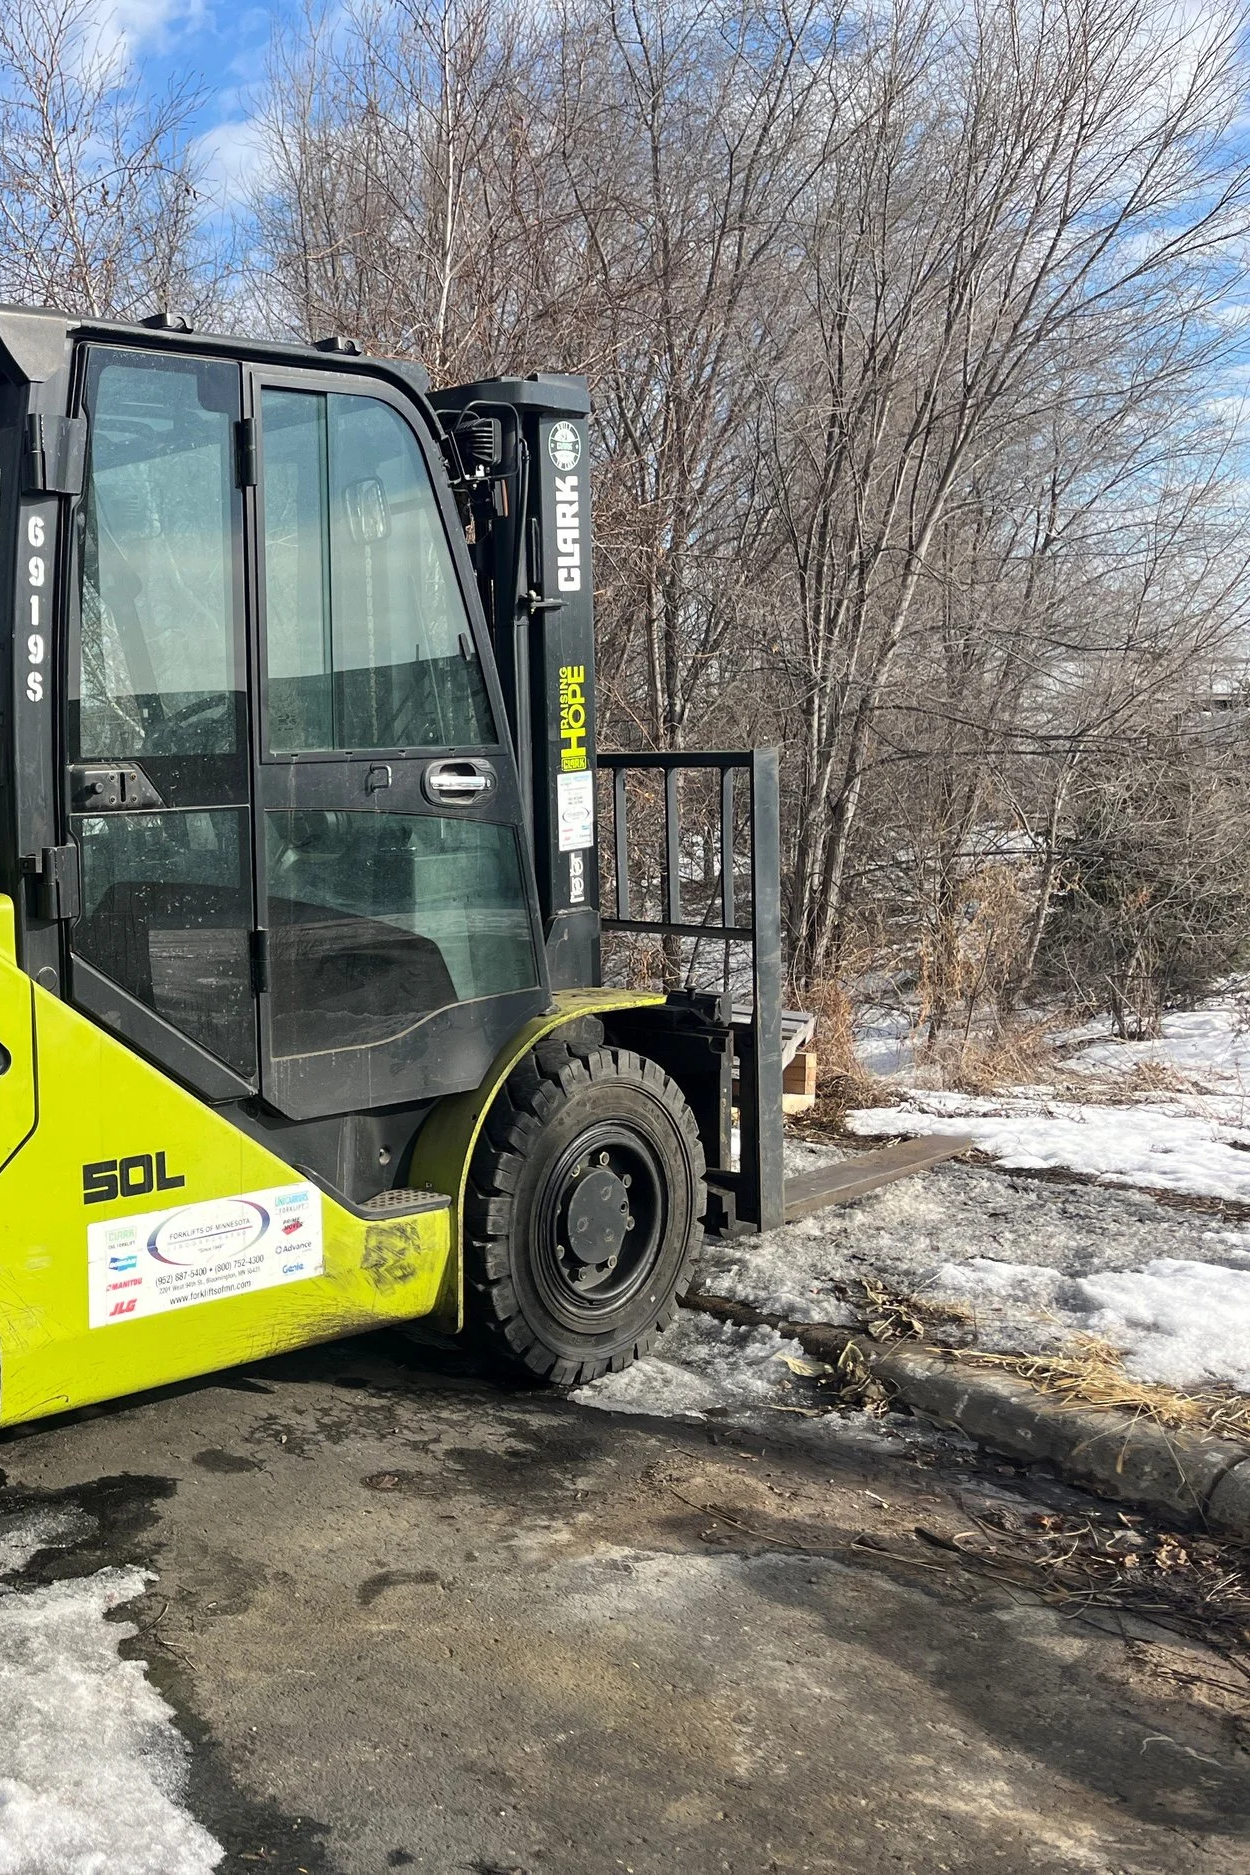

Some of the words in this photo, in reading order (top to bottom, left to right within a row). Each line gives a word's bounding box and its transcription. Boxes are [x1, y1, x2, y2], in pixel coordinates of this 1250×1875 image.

[555, 475, 581, 592] CLARK
[559, 666, 570, 729] RAISING
[560, 665, 587, 757] HOPE
[169, 1226, 204, 1240] FORKLIFTS
[205, 1223, 214, 1233] OF
[215, 1217, 250, 1231] MINNESOTA
[282, 1241, 312, 1253] Advance
[155, 1274, 174, 1287] (952)
[174, 1266, 207, 1282] 887-5400
[214, 1261, 232, 1275] (800)
[233, 1254, 264, 1269] 752-4300
[282, 1262, 305, 1274] Genie
[111, 1277, 143, 1291] MANITOU
[169, 1279, 252, 1305] www.forkliftsofmn.com
[109, 1298, 138, 1317] JLG
